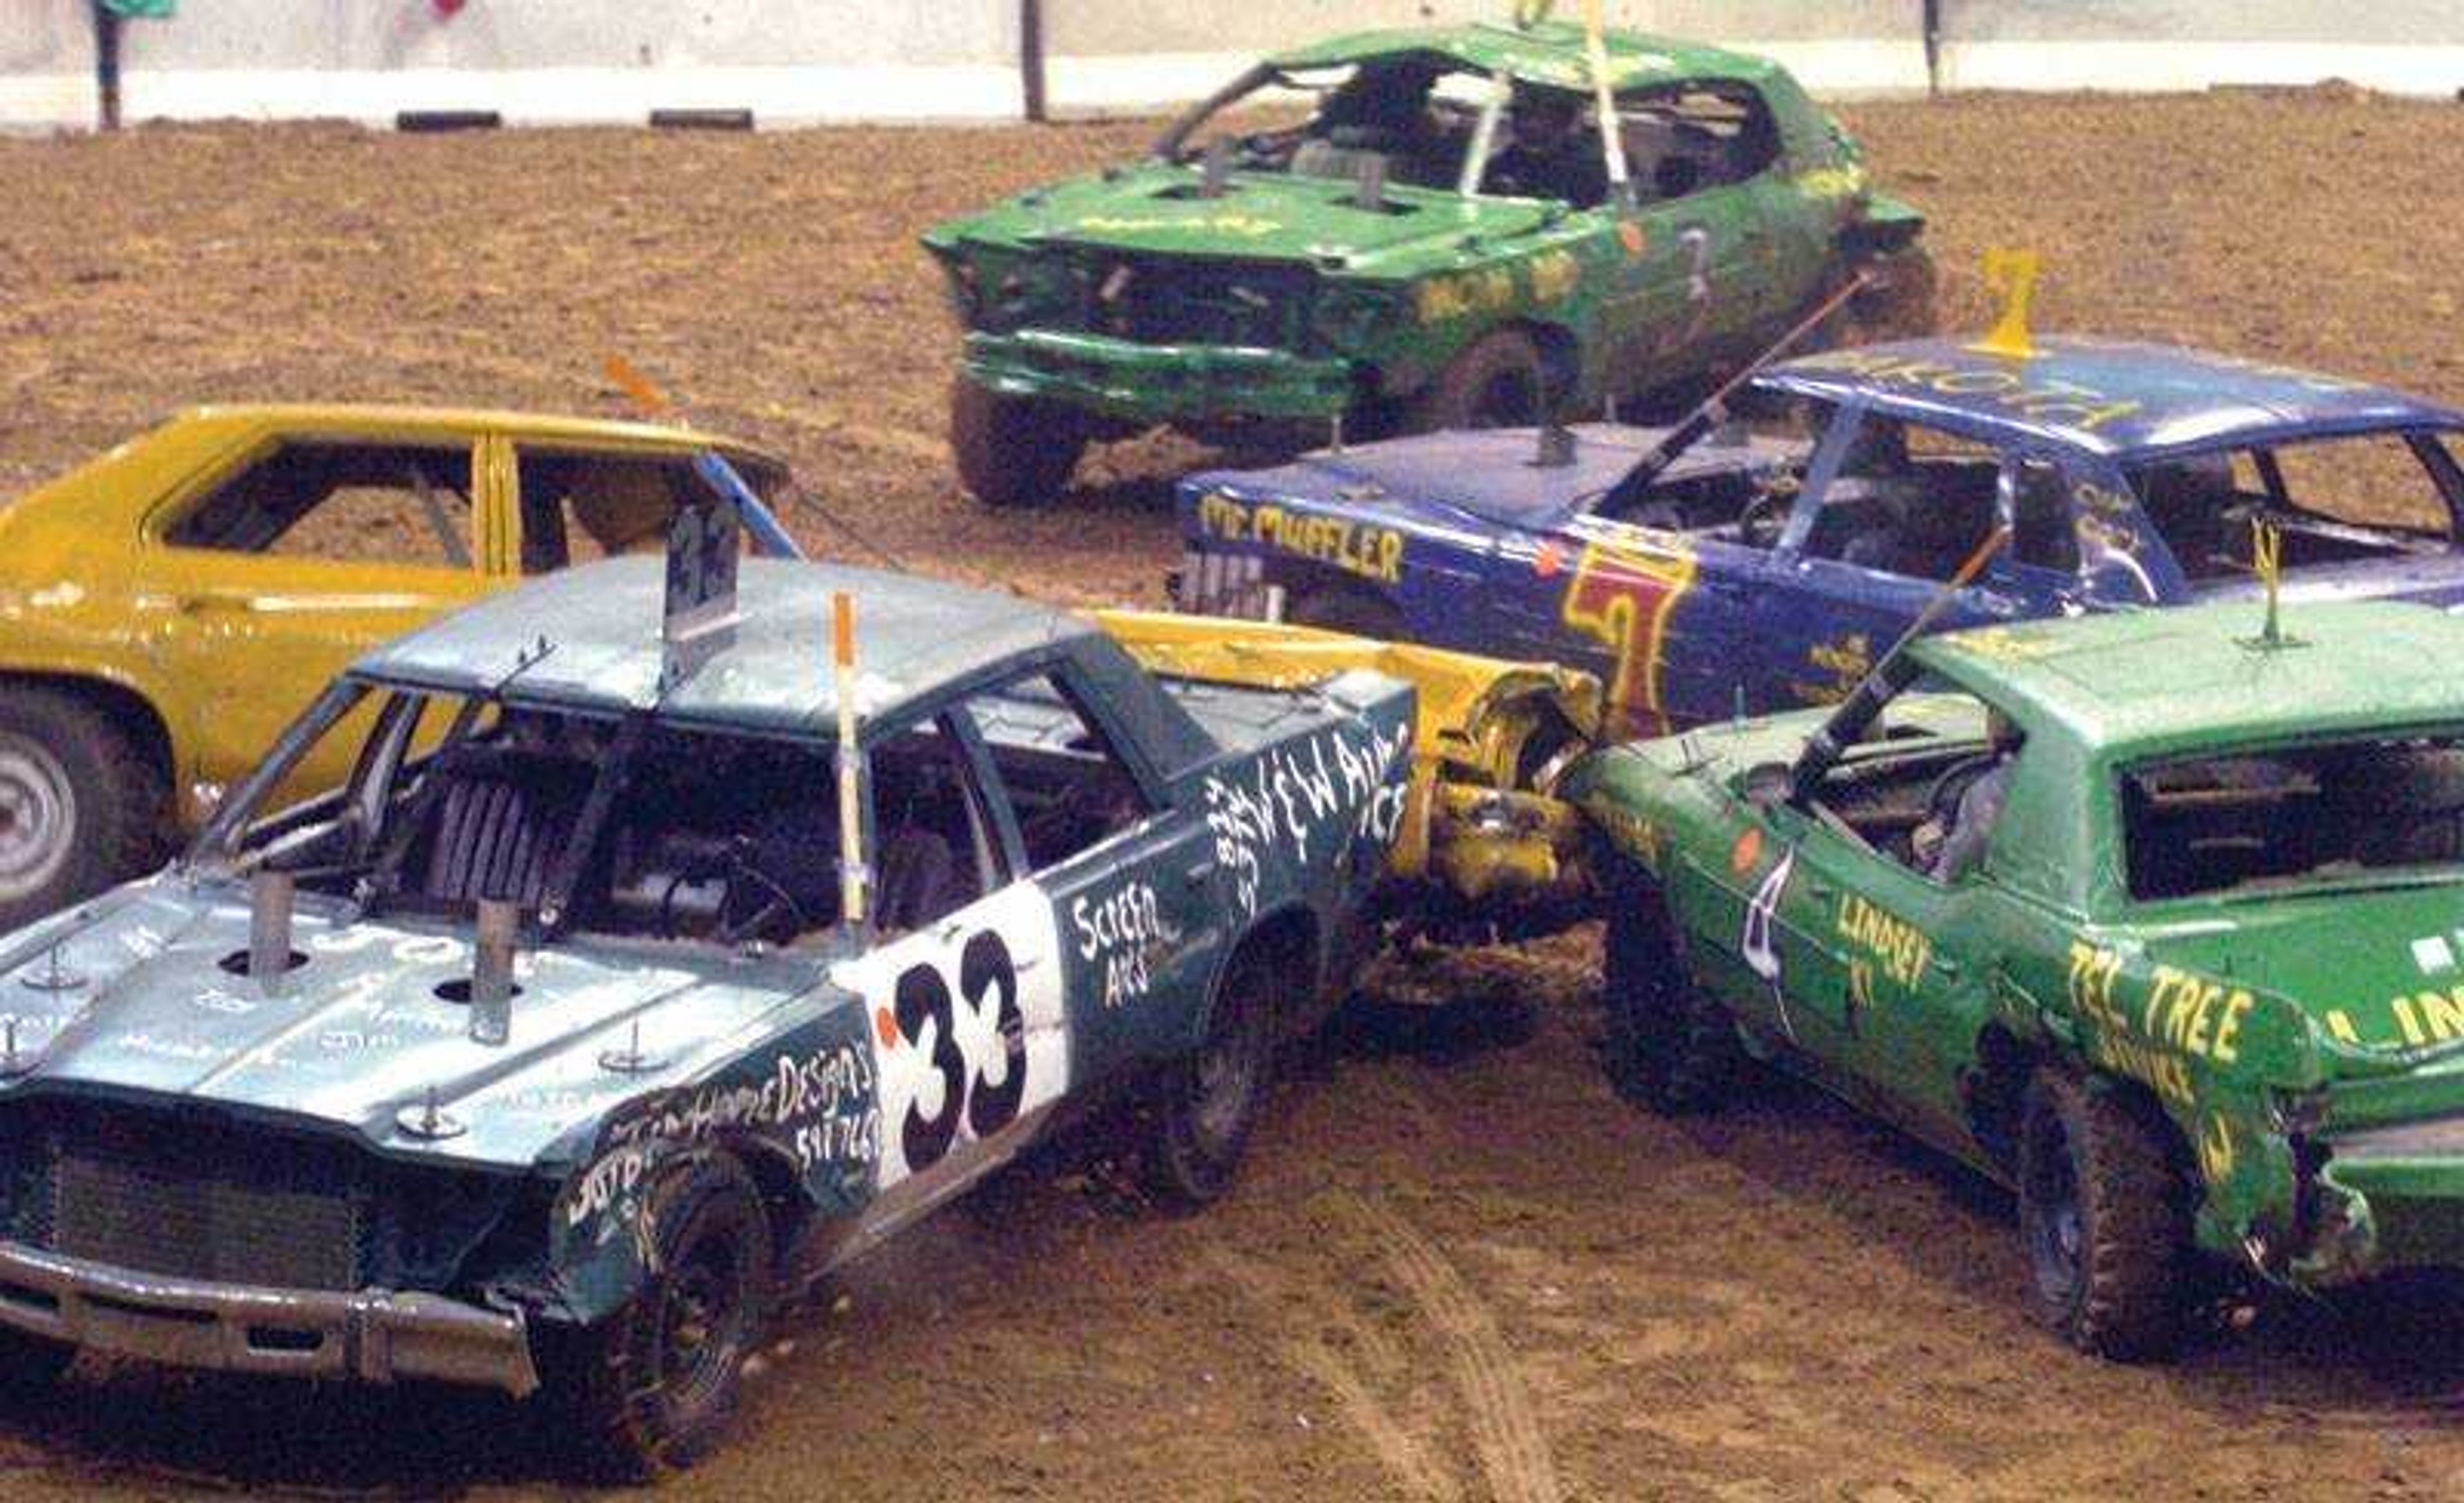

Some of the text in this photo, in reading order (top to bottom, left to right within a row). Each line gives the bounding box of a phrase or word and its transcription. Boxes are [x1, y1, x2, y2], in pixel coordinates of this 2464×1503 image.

[1563, 533, 1698, 741] 7
[894, 928, 1029, 1173] 33
[2145, 965, 2254, 1063] TREE
